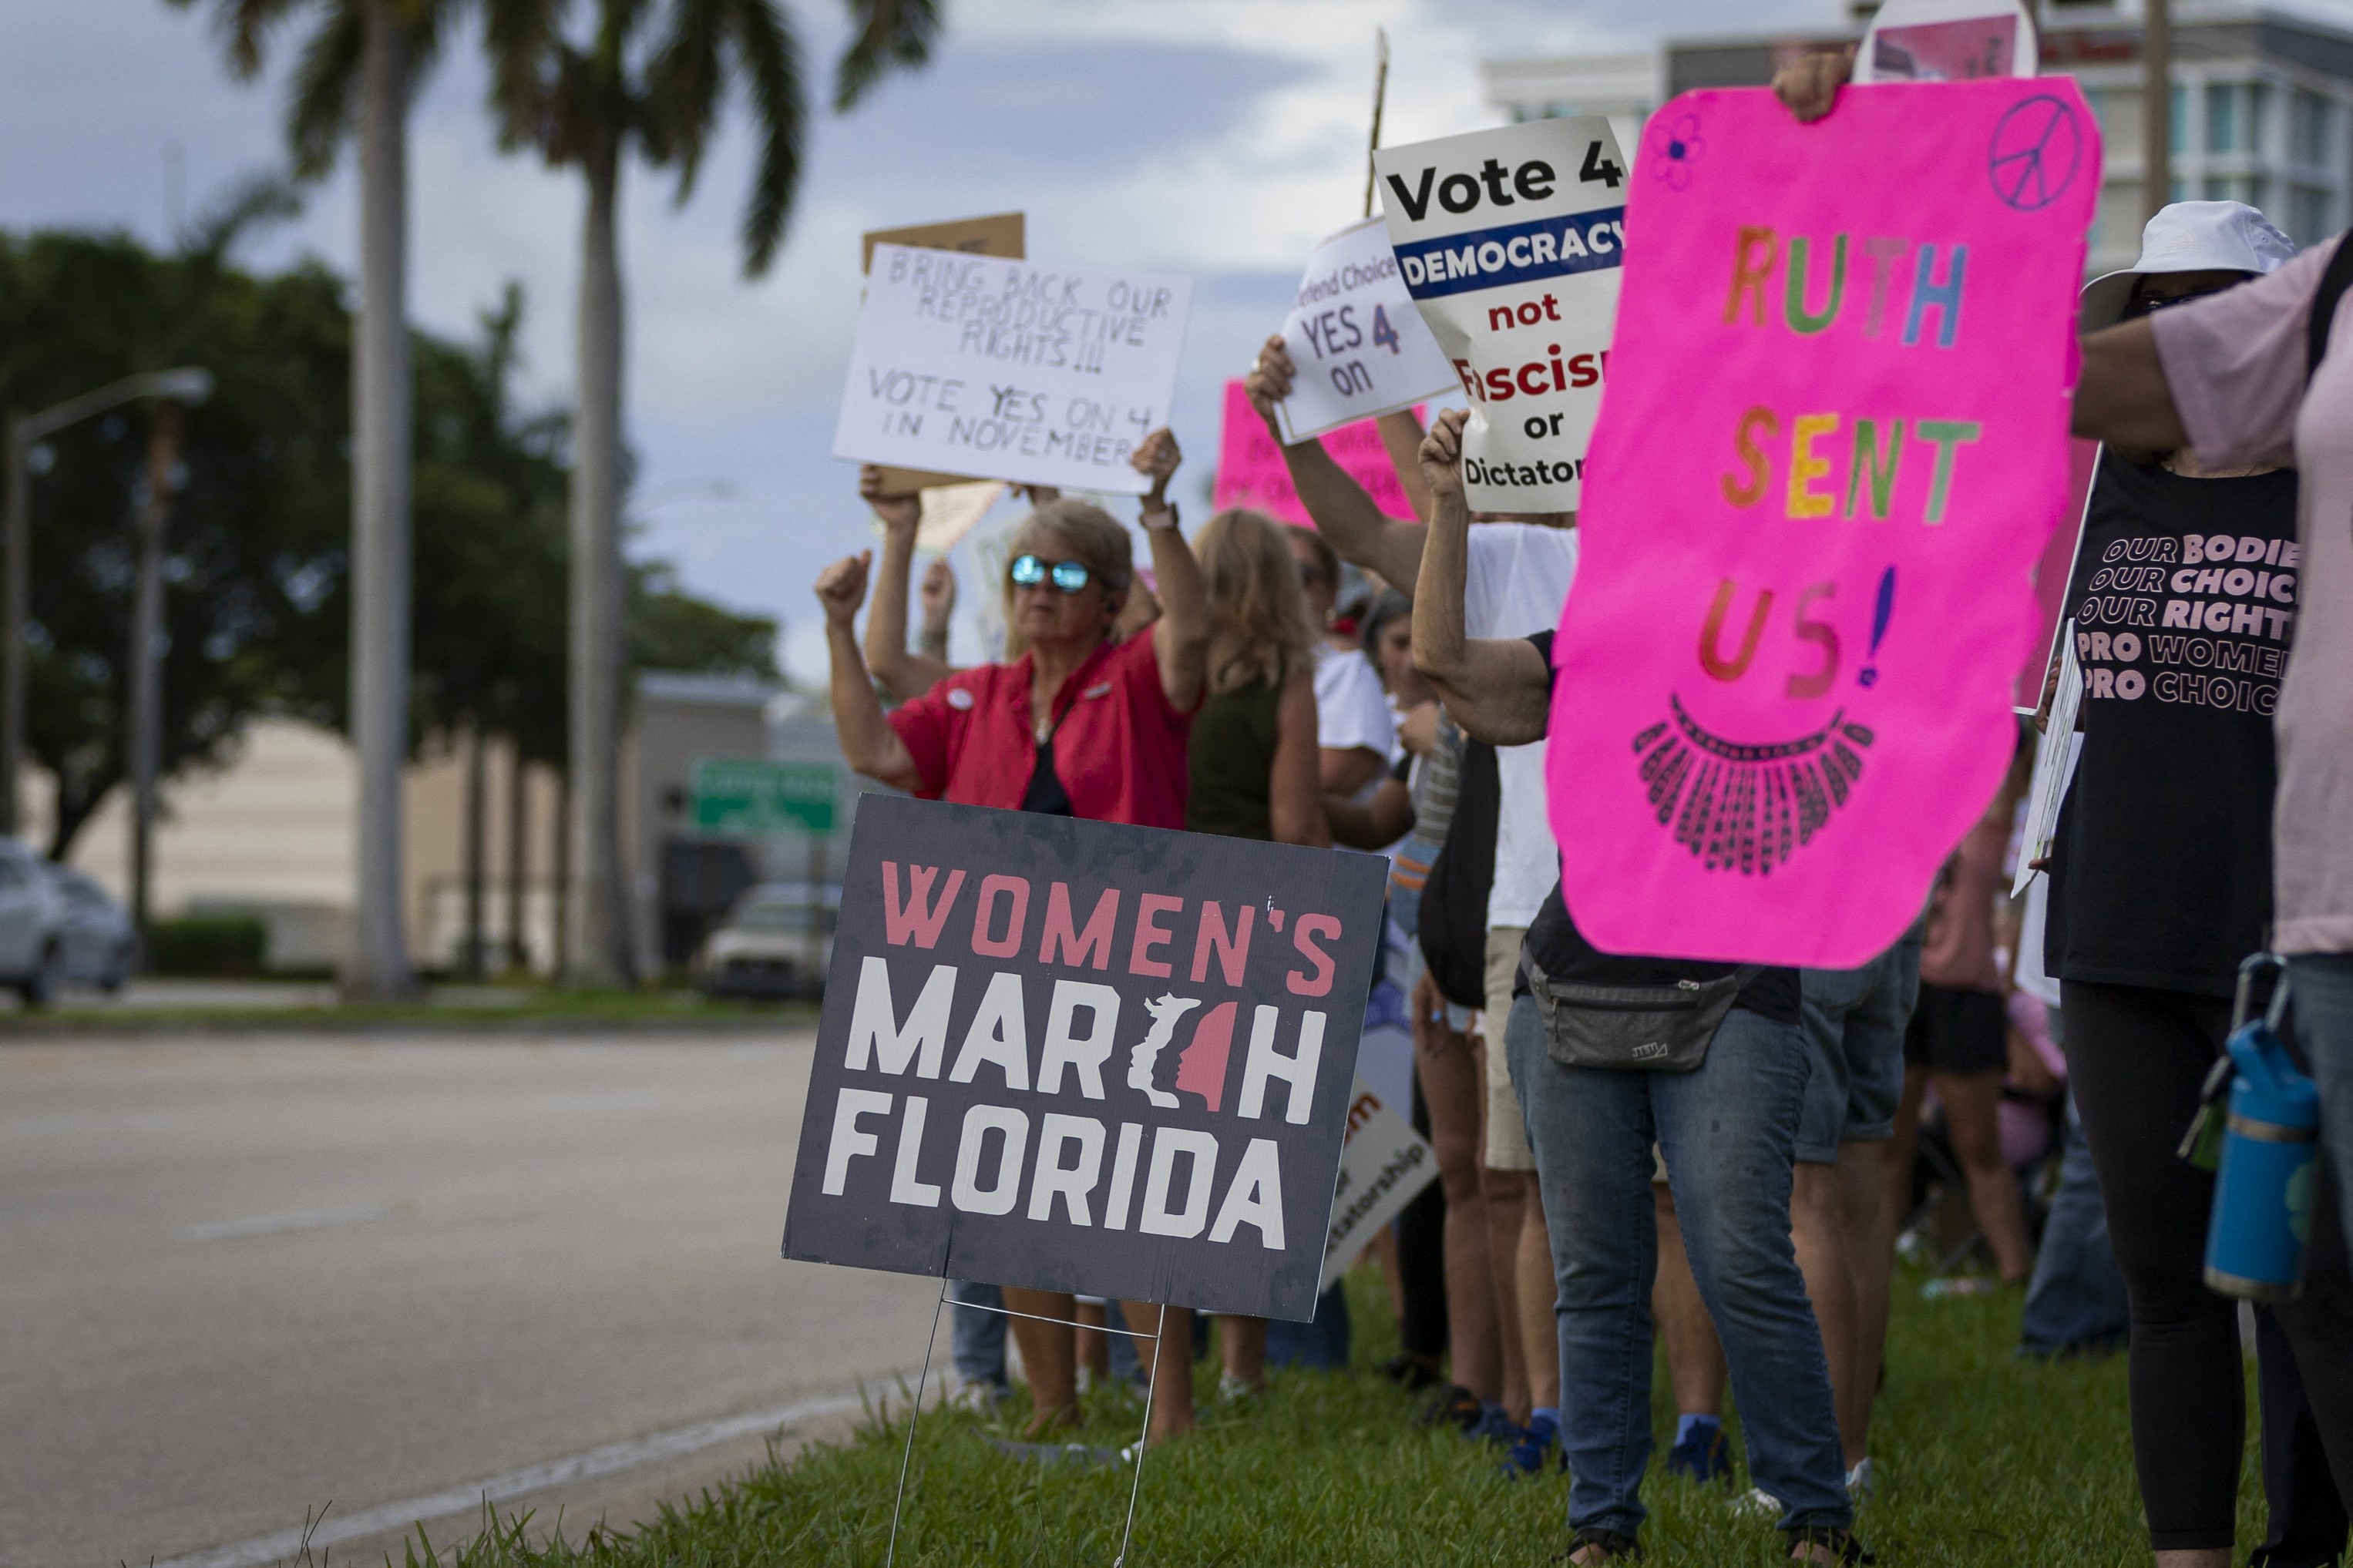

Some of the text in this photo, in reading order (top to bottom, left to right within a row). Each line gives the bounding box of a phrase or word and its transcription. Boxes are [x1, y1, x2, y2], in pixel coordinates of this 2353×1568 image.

[1386, 140, 1622, 222] Vote 4
[1341, 256, 1397, 290] Choice
[1402, 220, 1626, 286] DEMOCRACY
[889, 250, 1172, 319] BRING BACK OUR
[1488, 294, 1561, 331] not
[1723, 227, 1968, 348] RUTH
[918, 284, 1149, 346] REPRODUCTIVE
[1301, 303, 1400, 359] YES 4
[958, 318, 1107, 374] RIGHTS!!!
[1452, 344, 1610, 402] Fascis
[868, 366, 1151, 435] VOTE YES ON 4
[1330, 358, 1373, 396] on
[882, 411, 1134, 465] IN NOVEMBER
[1524, 412, 1564, 439] or
[1721, 405, 1982, 525] SENT
[2103, 537, 2178, 563] OUR
[2076, 596, 2156, 626] OUR
[2089, 567, 2300, 605] OUR CHOIC
[1699, 564, 1897, 700] US!
[2077, 632, 2141, 662] PRO
[882, 861, 1342, 996] WOMEN'S
[822, 1087, 1286, 1251] FLORIDA
